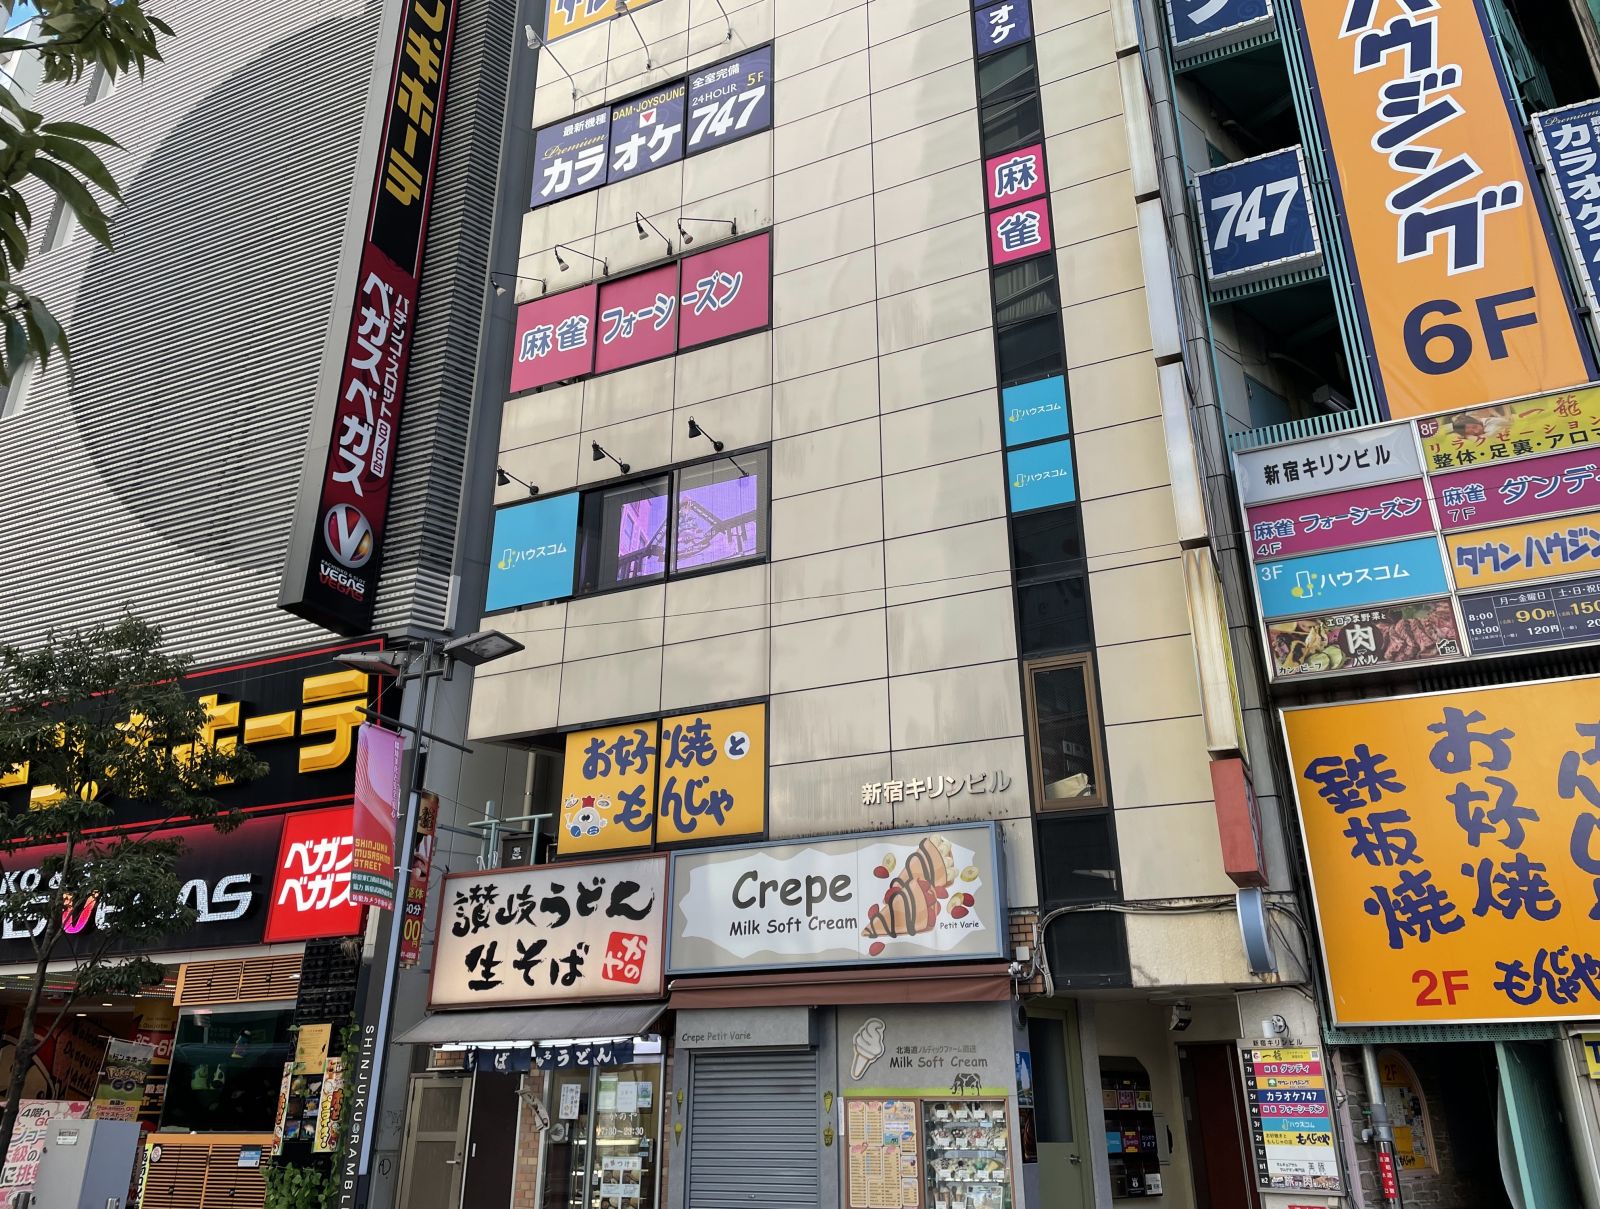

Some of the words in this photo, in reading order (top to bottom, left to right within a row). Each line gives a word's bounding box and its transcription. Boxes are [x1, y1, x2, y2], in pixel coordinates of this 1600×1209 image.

[692, 63, 740, 90] 全室完備
[747, 71, 764, 87] 5F
[692, 83, 738, 106] 24HOUR
[562, 112, 607, 137] 最新機種
[688, 85, 766, 146] 747
[541, 133, 609, 160] Premium
[995, 154, 1041, 252] 麻雀
[1210, 175, 1299, 251] 747
[519, 315, 589, 363] 麻雀
[601, 270, 743, 344] フォーシーズン
[1403, 286, 1538, 376] 6F
[1021, 402, 1061, 416] ハウスコム
[1420, 422, 1437, 436] 8F
[1027, 468, 1067, 482] ハウスコム
[1263, 444, 1391, 486] 新宿キリンビル
[1443, 482, 1486, 506] 麻雀
[1254, 520, 1295, 542] 麻雀
[1299, 497, 1422, 533] フォーシーズン
[1451, 508, 1476, 522] 7F
[515, 542, 567, 563] ハウスコム
[1257, 543, 1282, 556] 4F
[320, 563, 365, 594] VEGAS
[1261, 564, 1284, 581] 3F
[1320, 563, 1410, 590] ハウスコム
[1468, 612, 1494, 622] 8:00
[1345, 625, 1376, 654] 肉
[1469, 626, 1500, 636] 19:00
[1353, 656, 1378, 668] バル
[861, 770, 1012, 805] 新宿キリンビル
[613, 776, 735, 834] もんじゃ
[1427, 706, 1561, 921] お好焼
[1304, 744, 1466, 950] 鉄板焼
[731, 869, 853, 917] Crepe
[451, 877, 655, 938] 讃岐うどん
[729, 921, 760, 936] Milk
[766, 917, 802, 934] Soft
[808, 914, 858, 931] Cream
[939, 921, 957, 930] Petit
[960, 920, 980, 929] Varie
[465, 938, 592, 991] 生そば
[1411, 970, 1469, 1007] 2F
[682, 1032, 705, 1044] Crepe
[707, 1031, 728, 1041] Petit
[730, 1031, 751, 1041] Varie
[557, 1047, 612, 1067] うどん
[890, 1057, 913, 1068] Milk
[918, 1056, 944, 1068] Soft
[951, 1056, 988, 1067] Cream
[353, 1025, 374, 1122] SHINJUKU
[1385, 1064, 1397, 1081] 2F
[1267, 1092, 1317, 1101] カラオケ747
[340, 1134, 359, 1209] RAMBL
